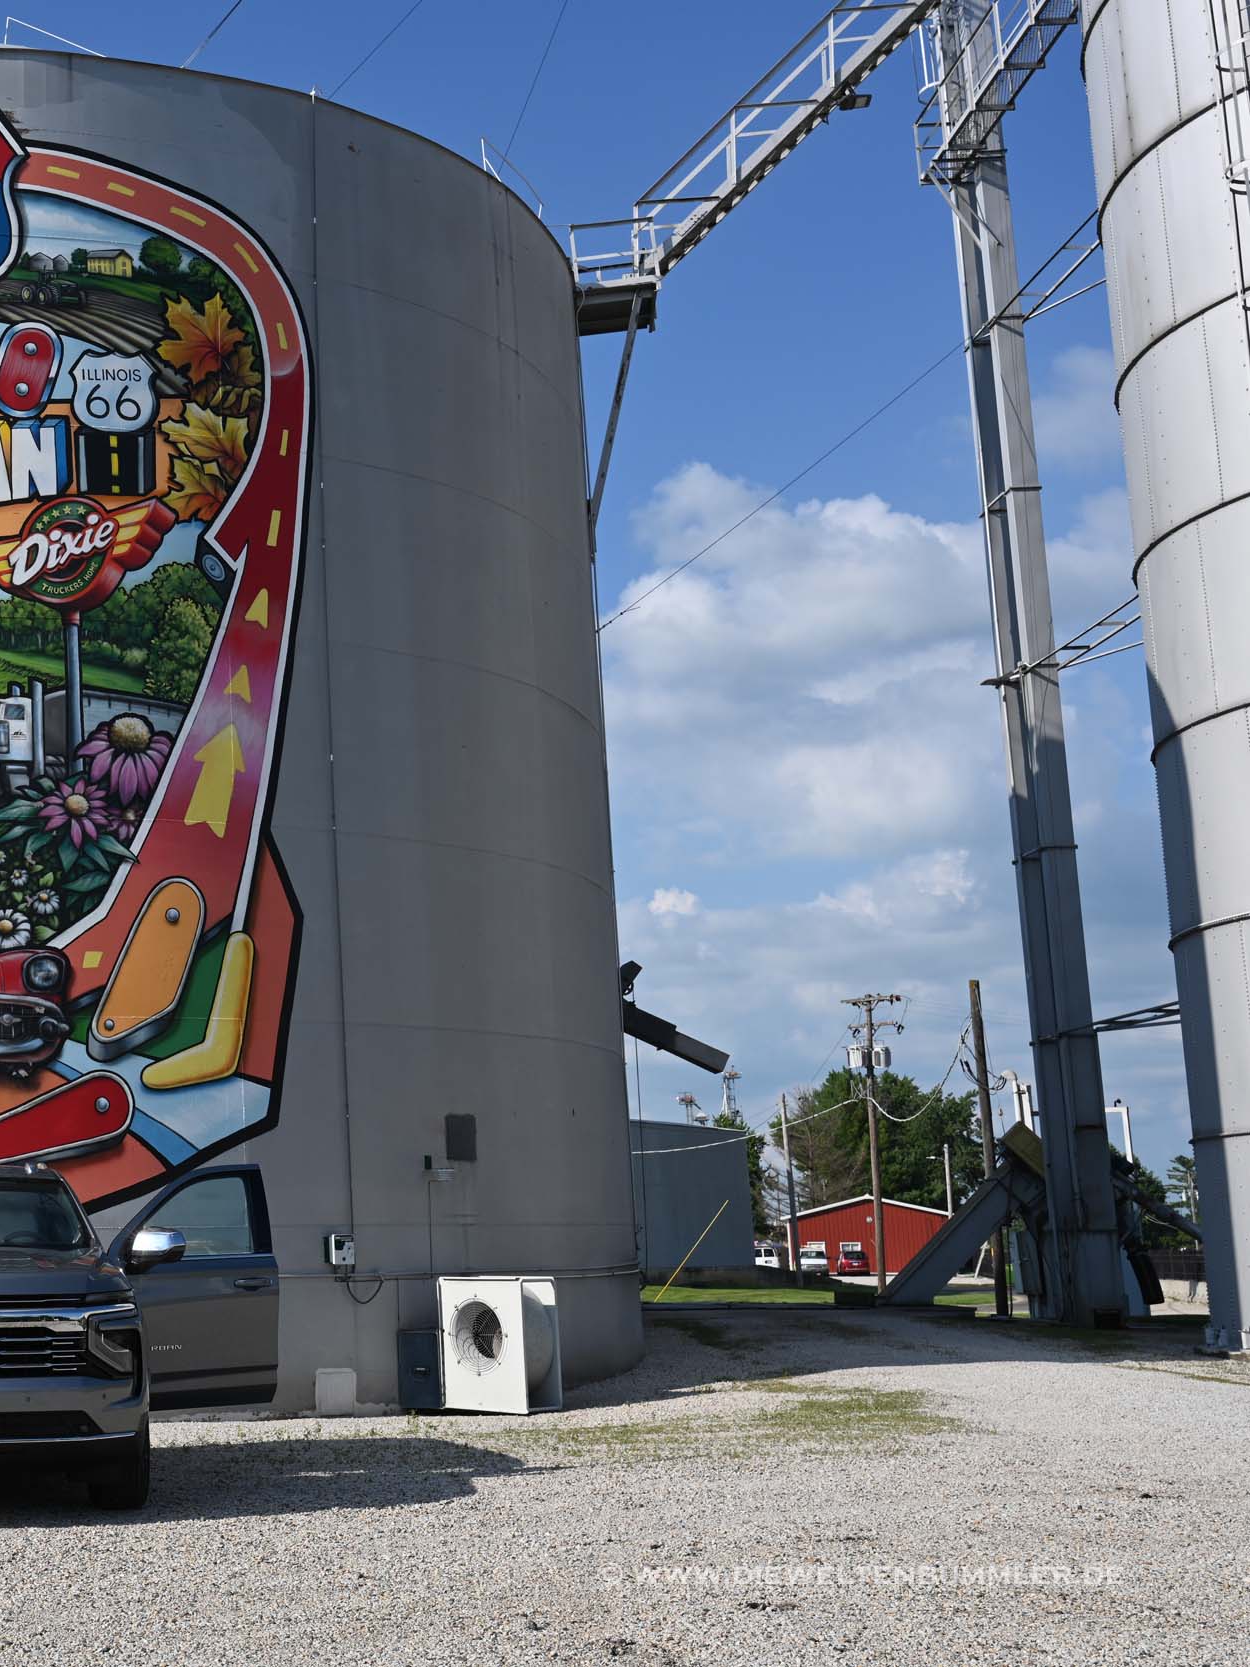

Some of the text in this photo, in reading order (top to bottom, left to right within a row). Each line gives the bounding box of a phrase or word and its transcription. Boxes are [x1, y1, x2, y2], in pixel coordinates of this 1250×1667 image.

[82, 368, 142, 383] ILLINOIS
[86, 384, 142, 421] 66
[9, 512, 114, 585] Dixie
[41, 561, 98, 595] TRUCKERS HOME
